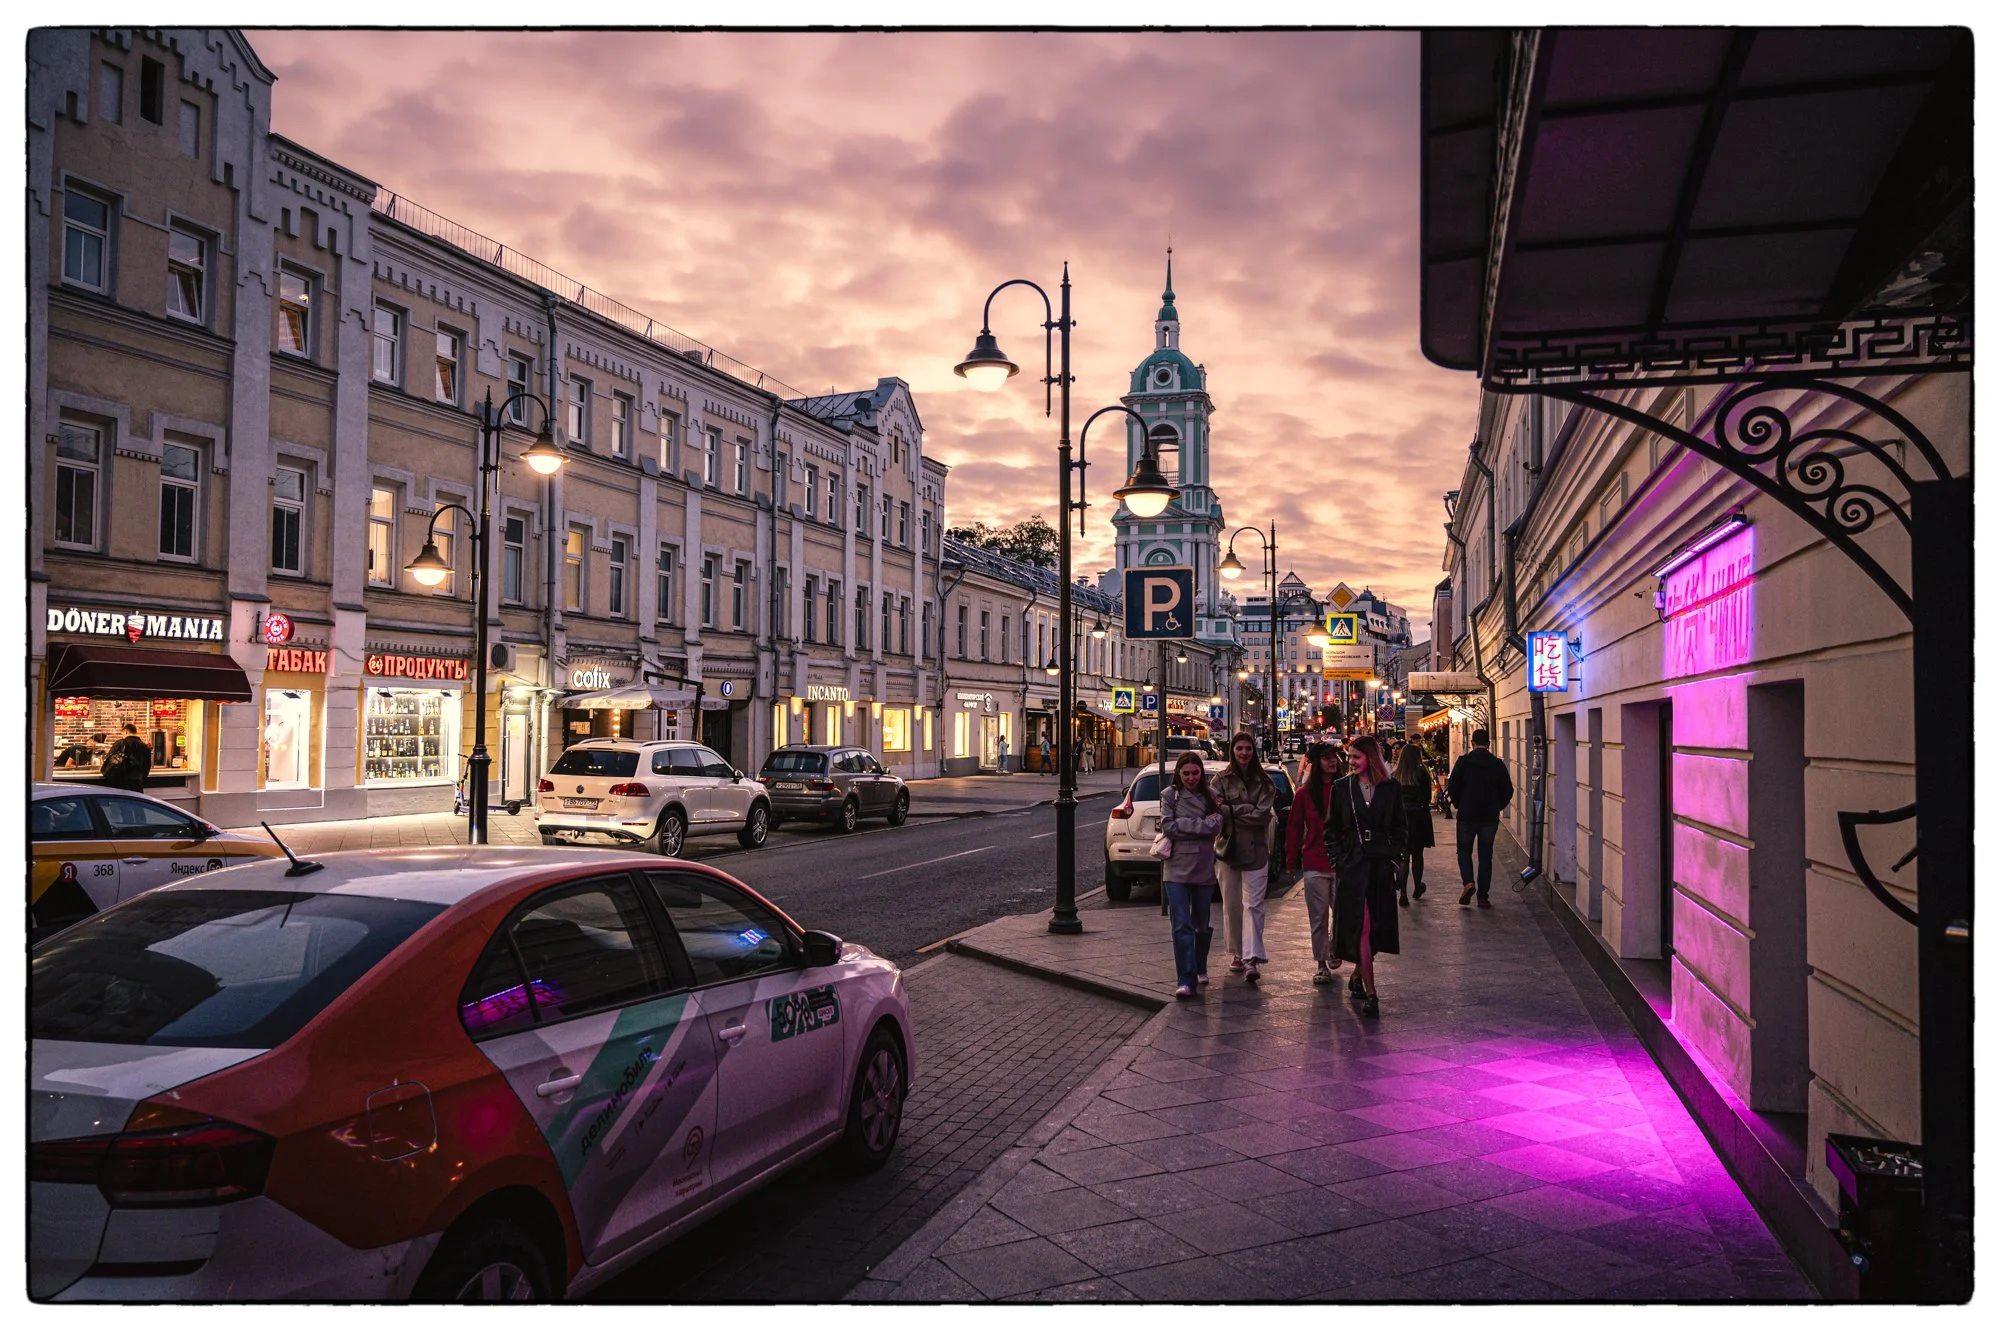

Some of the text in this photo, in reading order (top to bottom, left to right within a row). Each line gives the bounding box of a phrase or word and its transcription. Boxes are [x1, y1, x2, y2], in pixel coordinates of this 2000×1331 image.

[1143, 577, 1182, 632] P
[47, 607, 223, 640] DÖNER MANIA
[266, 648, 327, 673] ТАБАК
[383, 655, 468, 680] ПРОДУКТЫ
[1534, 634, 1562, 689] 吃货
[571, 666, 611, 689] cofix
[807, 685, 849, 702] INCANTO
[1146, 695, 1156, 709] P
[64, 866, 73, 879] Я
[93, 864, 114, 877] 368
[170, 862, 205, 875] Яндекс
[581, 1046, 653, 1156] делимобиль
